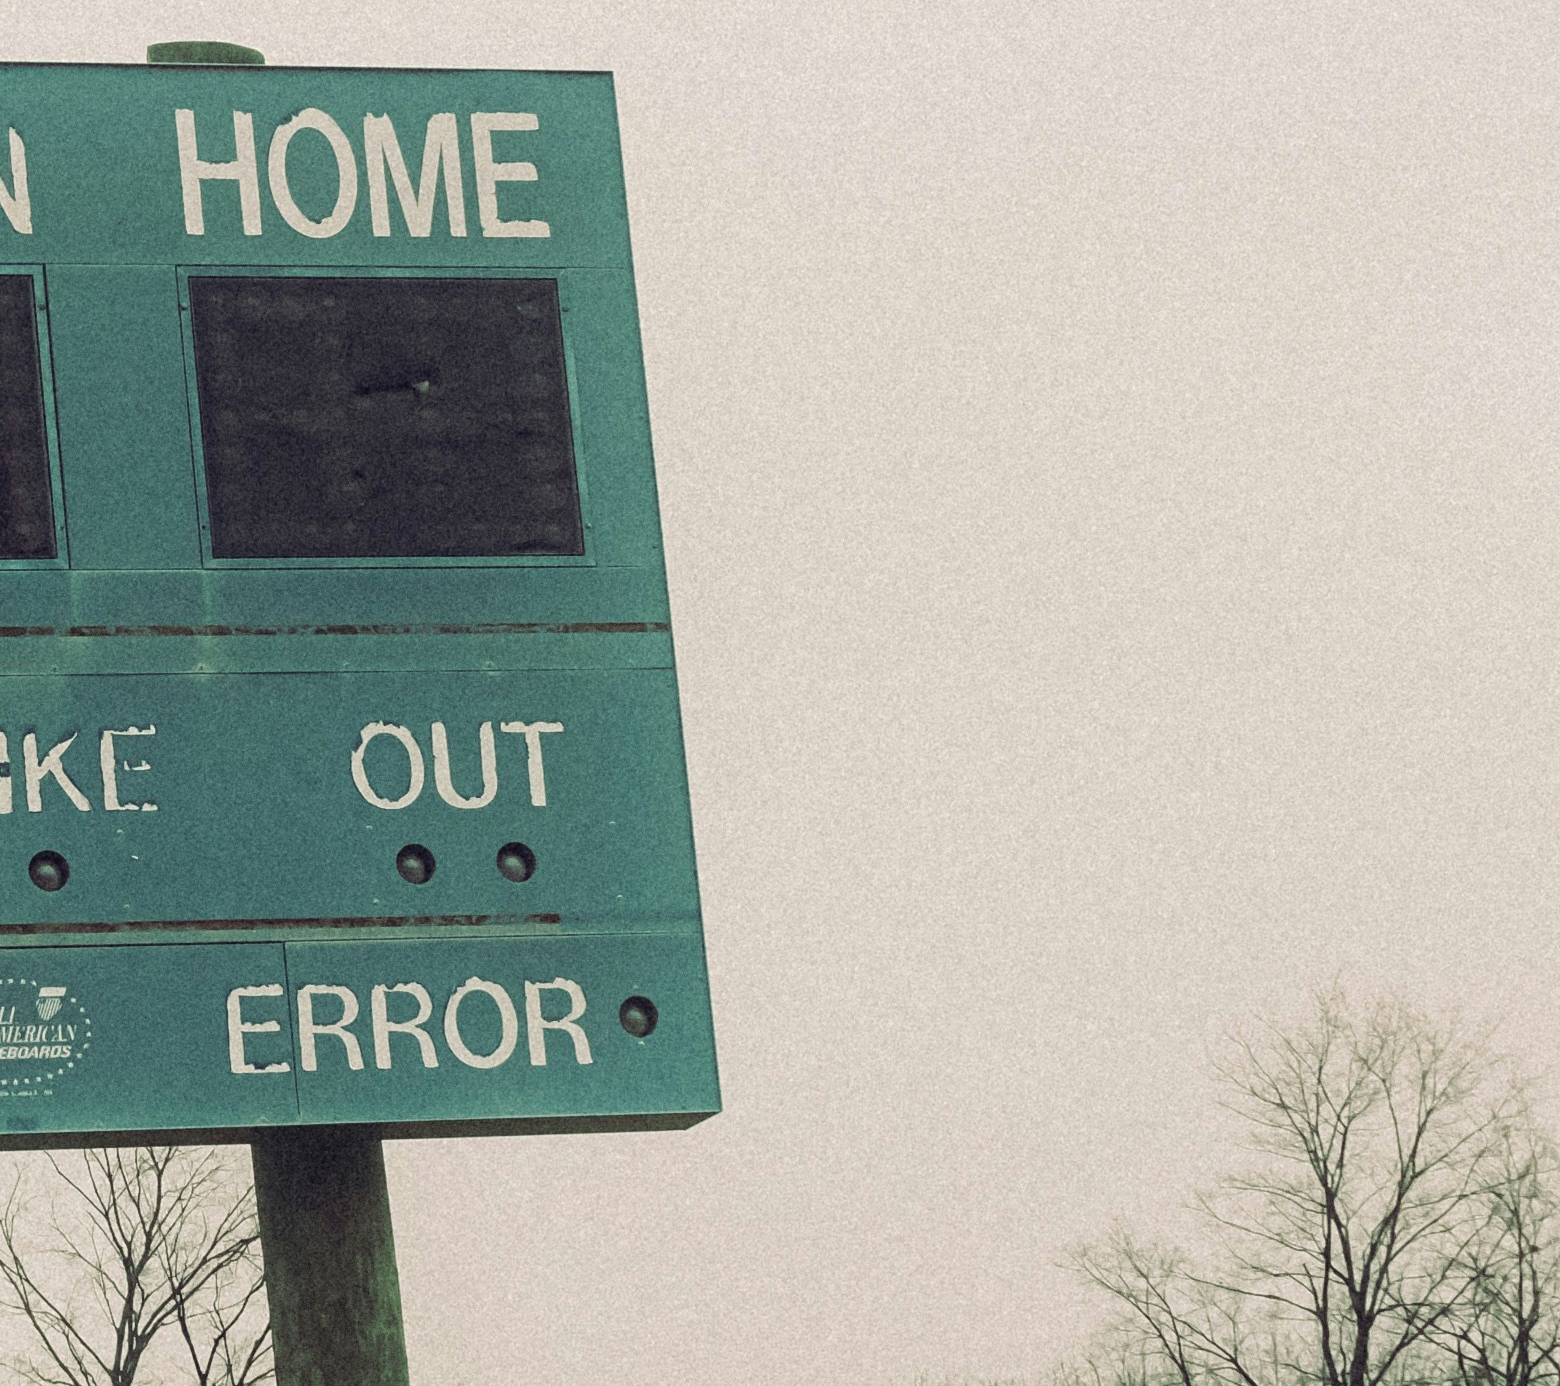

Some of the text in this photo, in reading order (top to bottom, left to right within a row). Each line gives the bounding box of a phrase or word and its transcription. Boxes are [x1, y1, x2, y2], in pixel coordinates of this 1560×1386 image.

[175, 107, 551, 239] HOME
[350, 721, 565, 810] OUT
[226, 976, 593, 1075] ERROR
